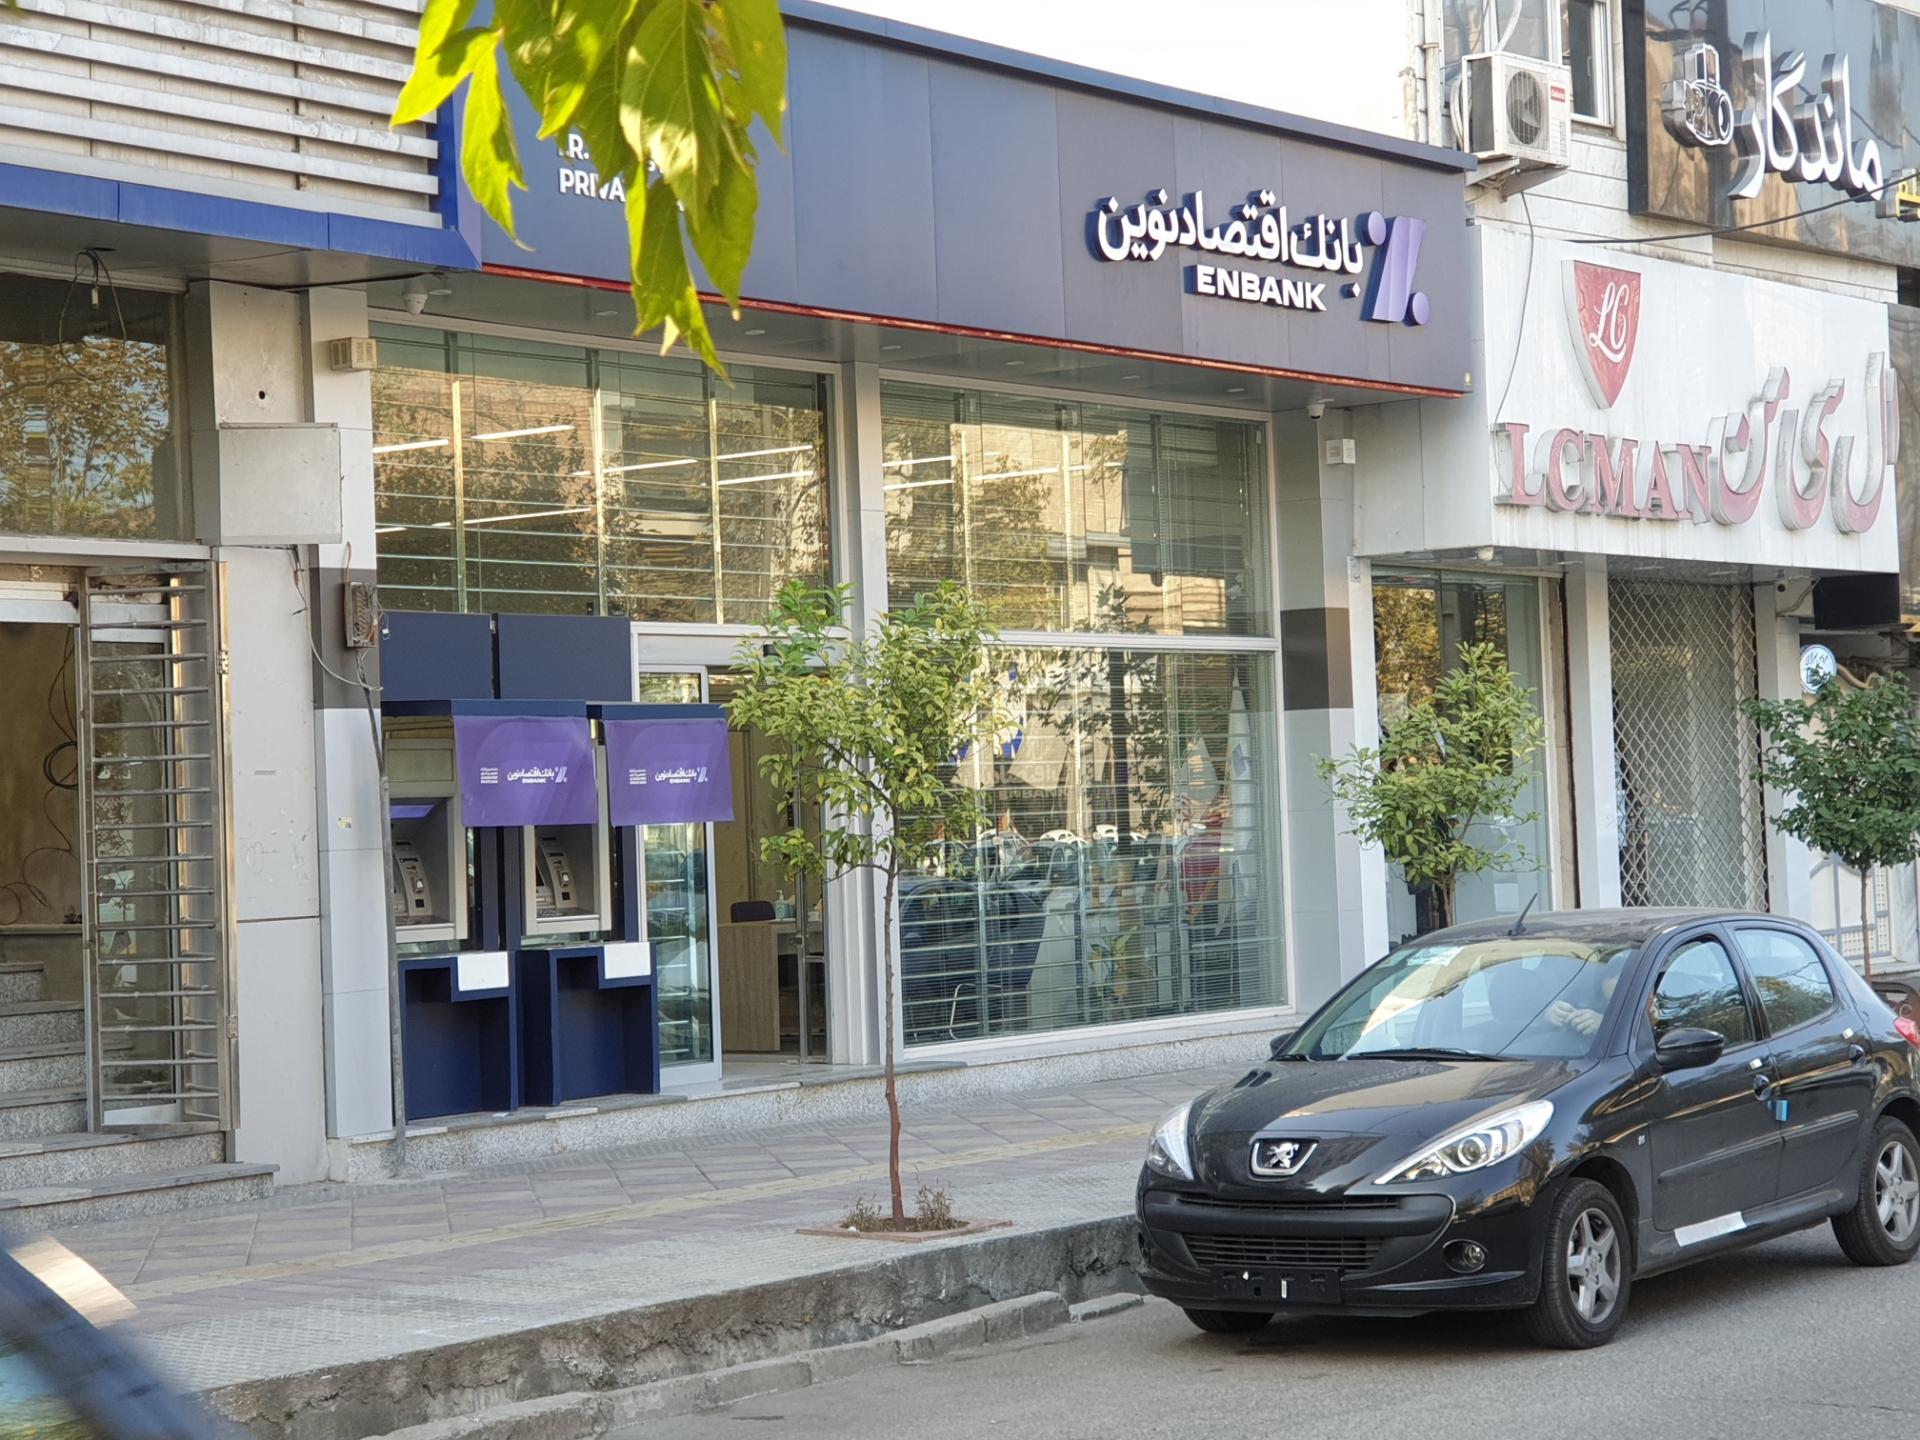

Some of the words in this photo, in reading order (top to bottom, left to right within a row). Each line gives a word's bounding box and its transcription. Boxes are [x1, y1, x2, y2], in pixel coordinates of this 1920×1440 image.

[1728, 30, 1884, 201] ماندگار
[558, 167, 627, 203] PRIVA
[1096, 187, 1179, 261] نوین
[1178, 189, 1290, 262] اقتصاد
[1194, 263, 1328, 312] ENBANK
